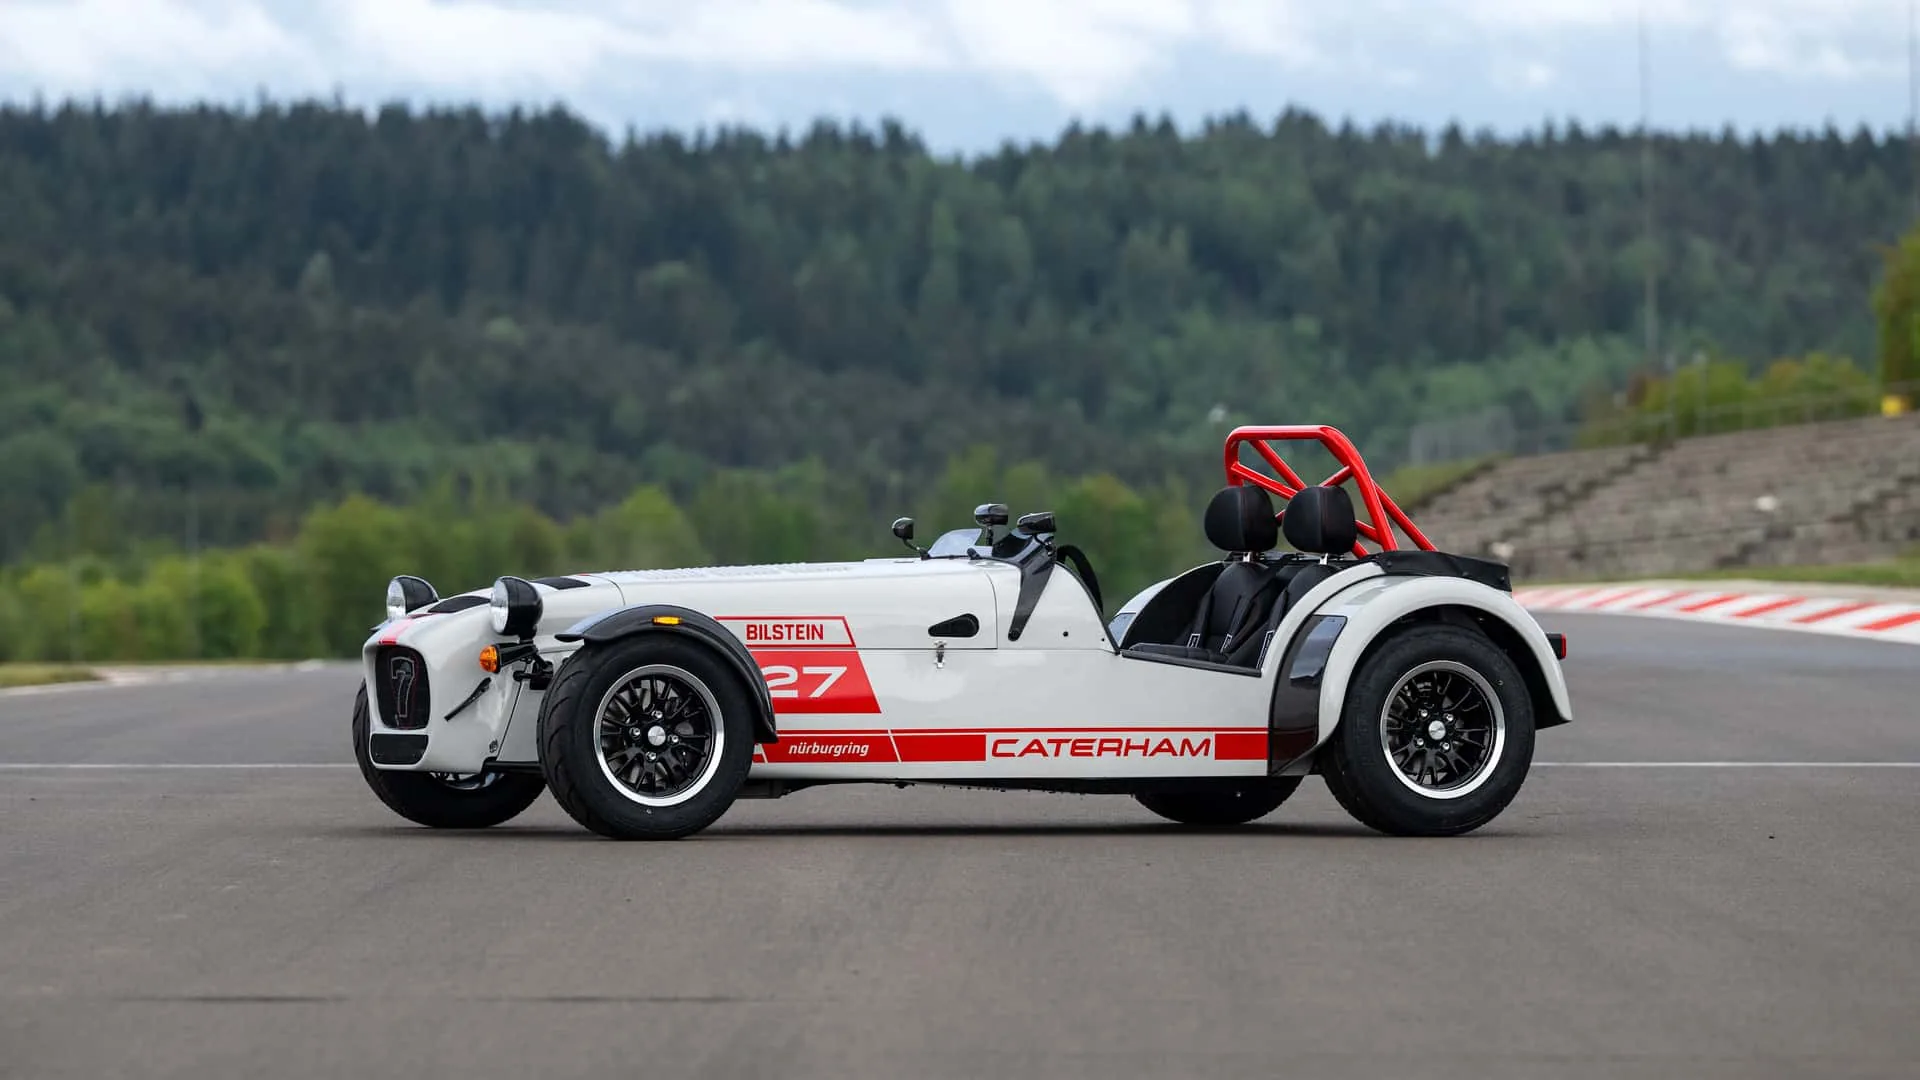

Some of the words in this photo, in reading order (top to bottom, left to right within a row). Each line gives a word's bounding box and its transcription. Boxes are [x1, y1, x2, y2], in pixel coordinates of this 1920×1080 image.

[746, 624, 824, 640] BILSTEIN
[391, 657, 415, 717] 7
[761, 665, 847, 698] 27
[788, 742, 870, 757] nürburgring
[991, 738, 1211, 757] CATERHAM
